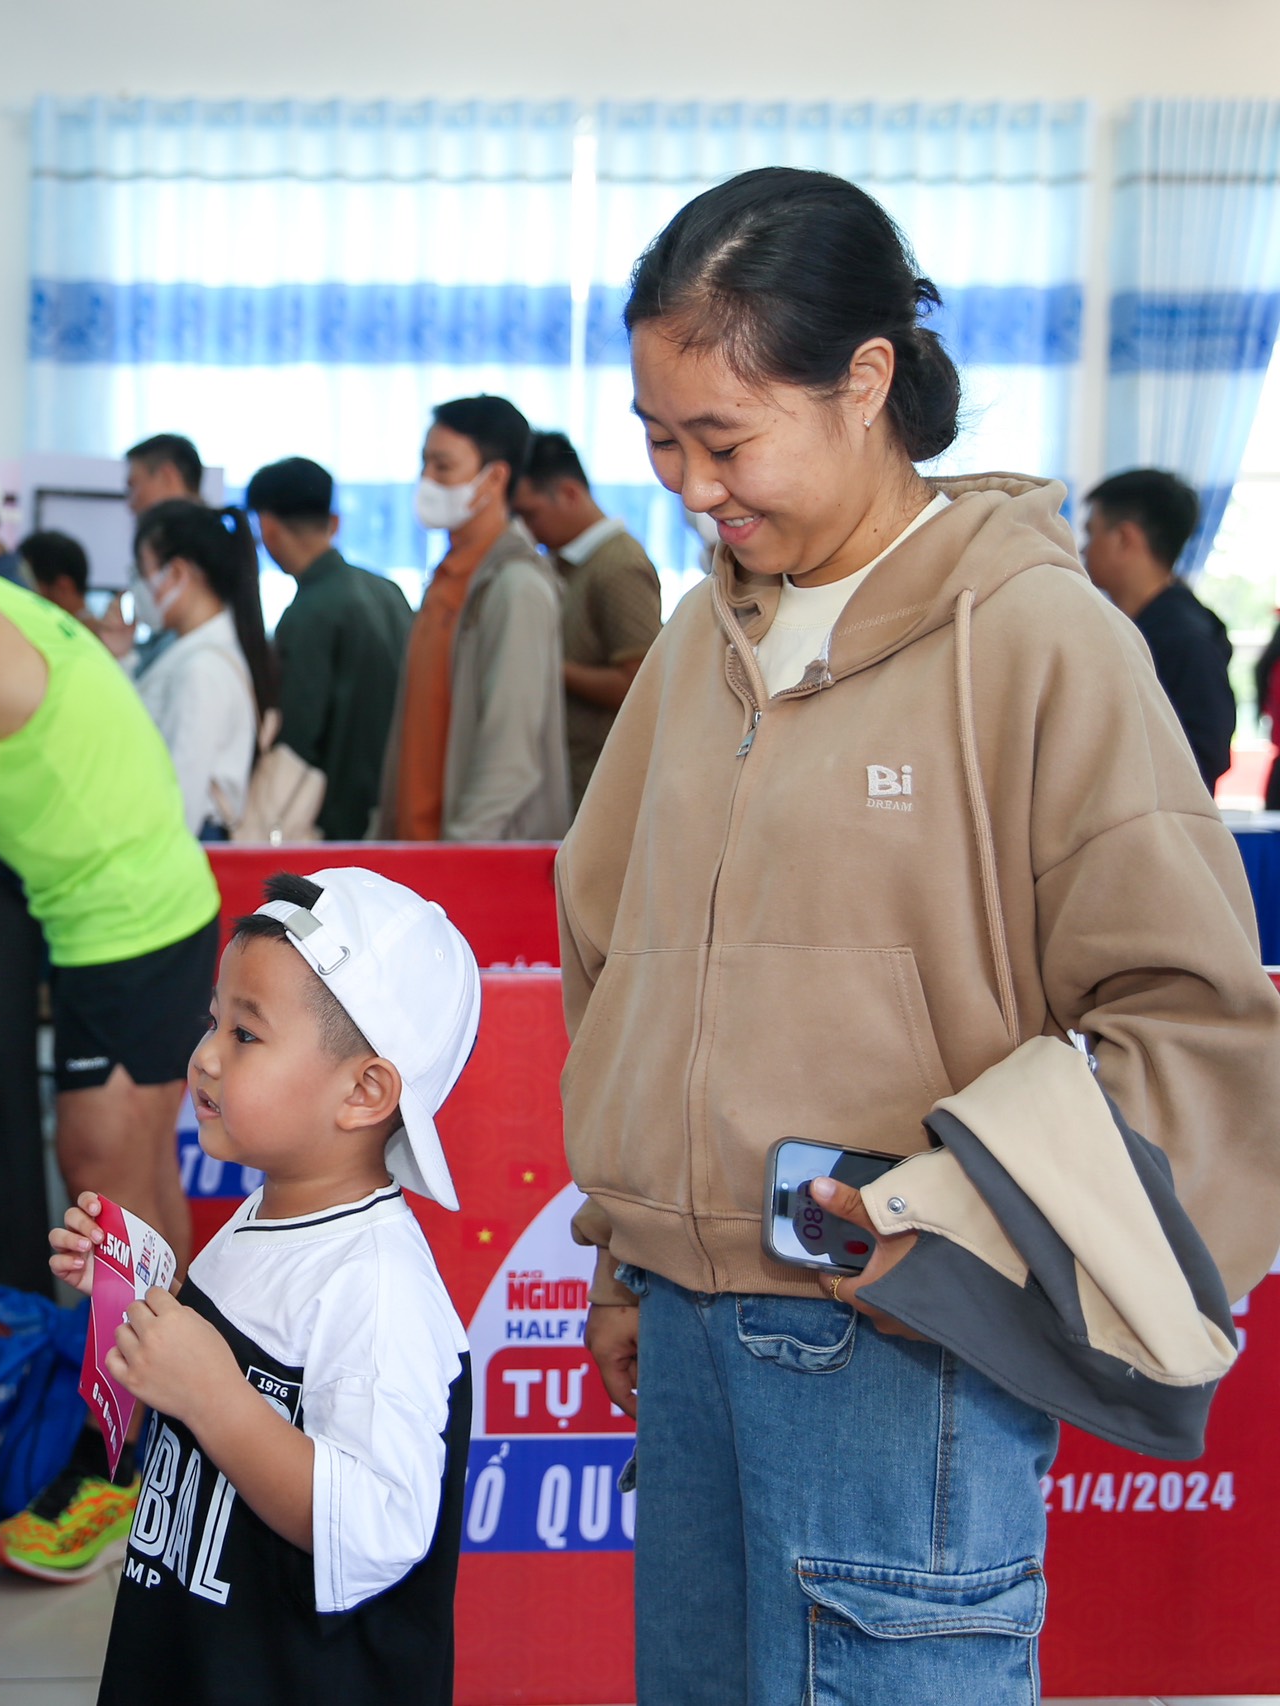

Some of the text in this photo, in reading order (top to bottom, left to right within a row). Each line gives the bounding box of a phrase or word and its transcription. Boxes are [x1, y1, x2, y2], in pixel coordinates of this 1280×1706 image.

[866, 764, 912, 796] Bi
[866, 798, 913, 812] DREAM
[506, 1320, 569, 1340] HALF
[257, 1377, 289, 1398] 1976
[502, 1362, 590, 1430] TỰ
[465, 1441, 510, 1543] Ổ
[123, 1556, 162, 1589] MP
